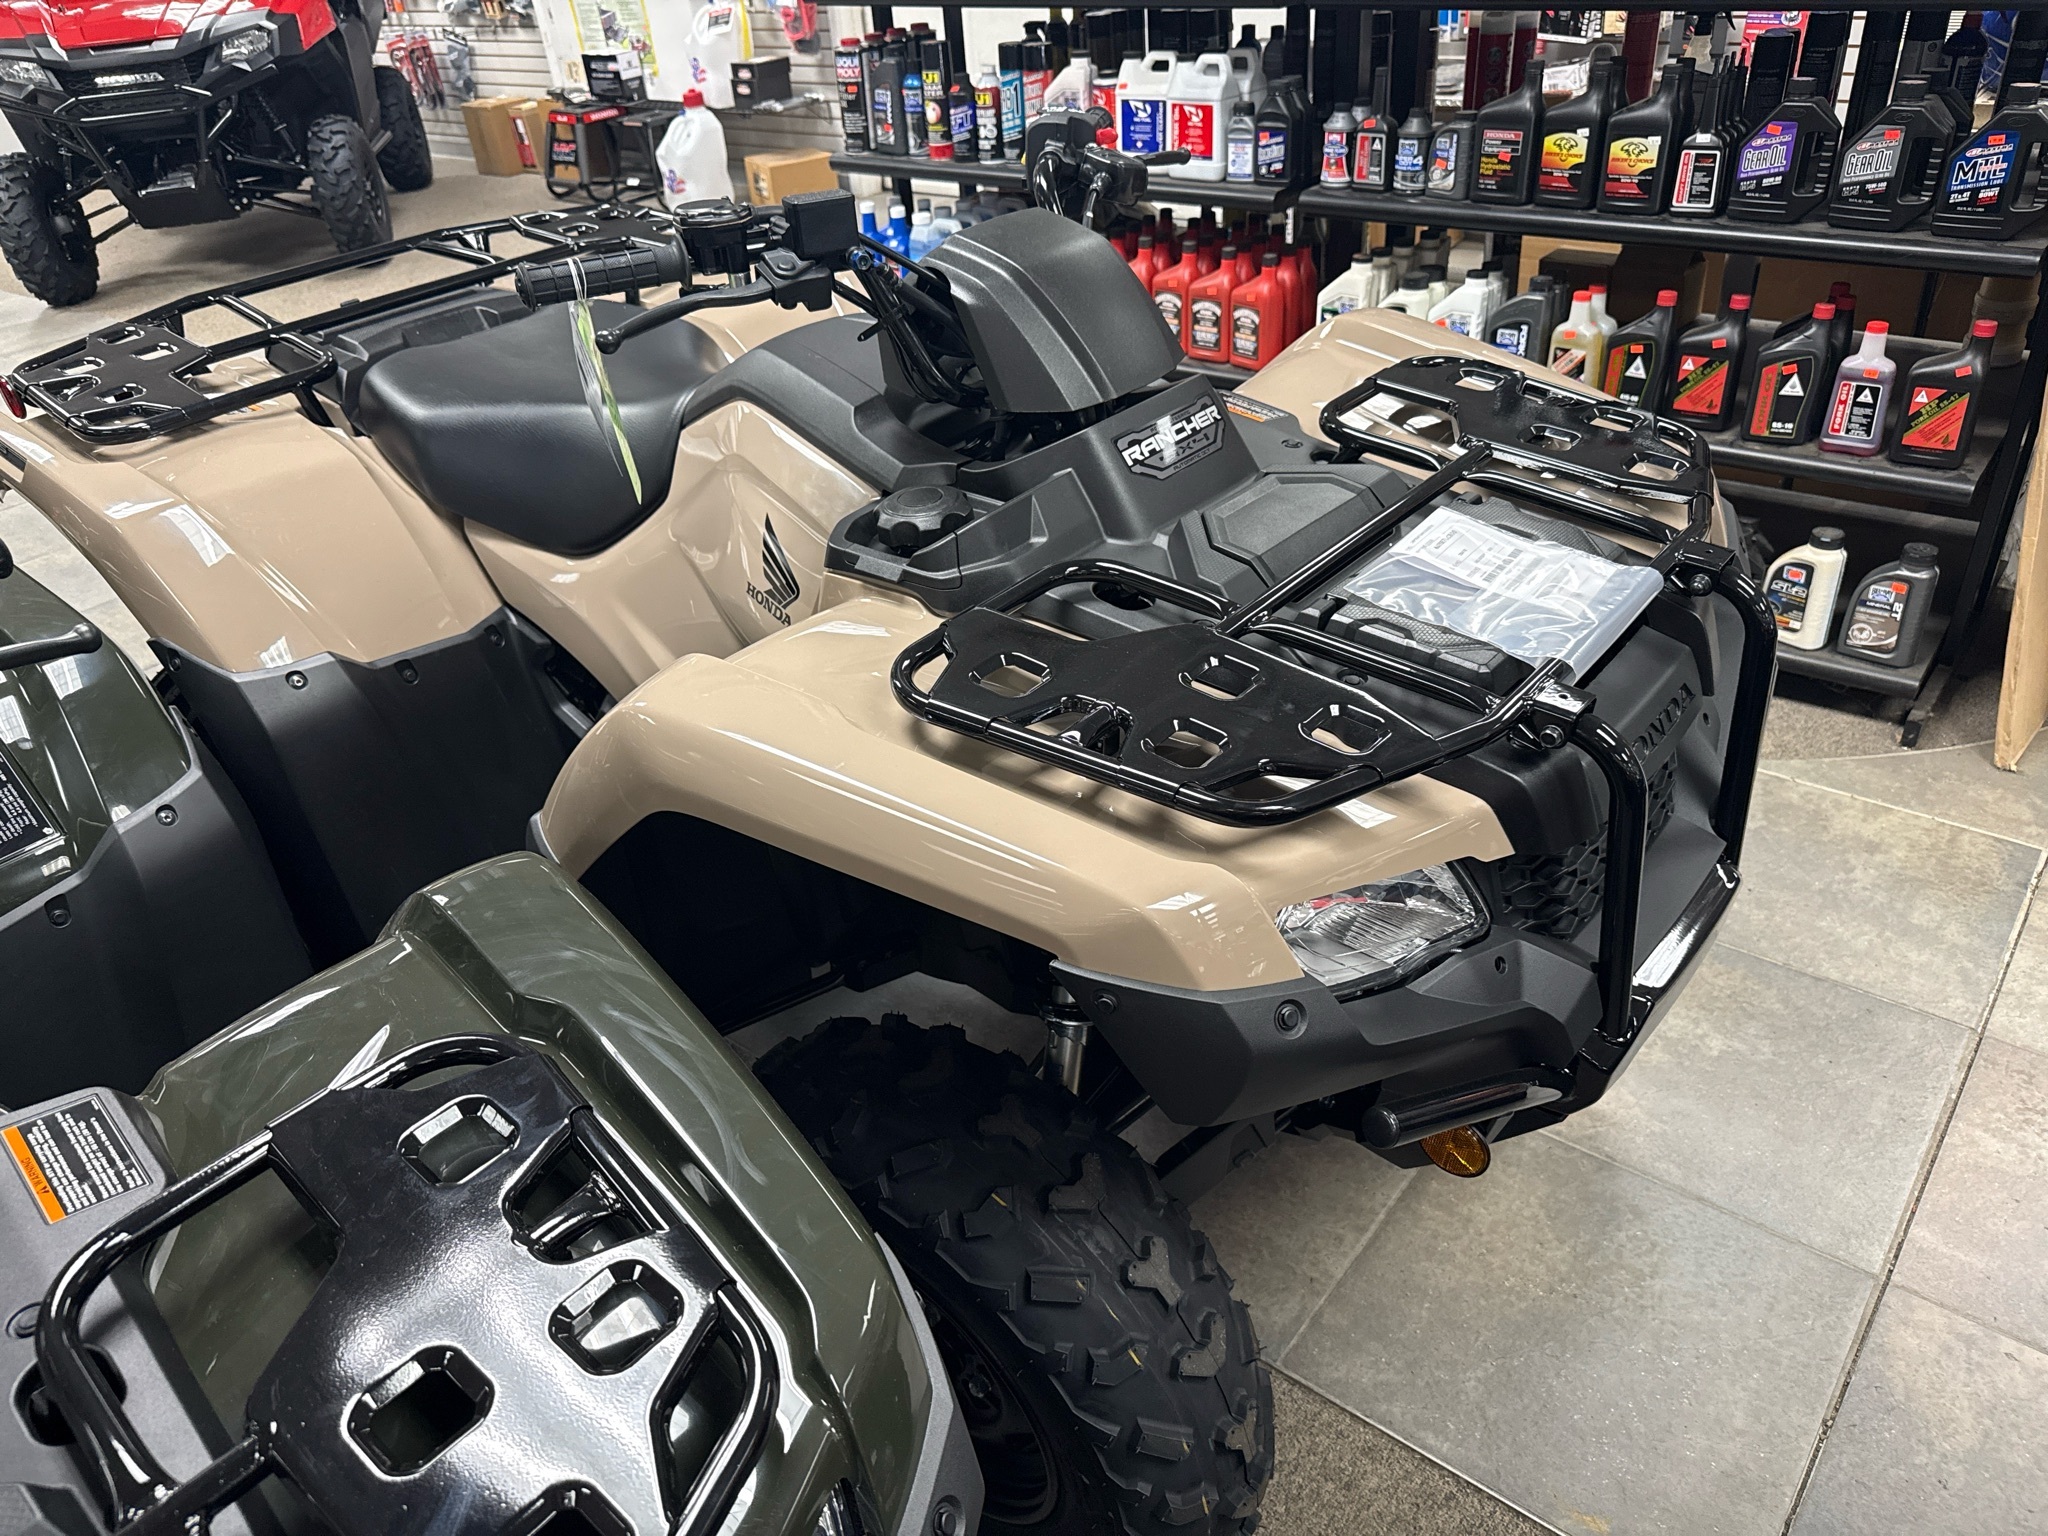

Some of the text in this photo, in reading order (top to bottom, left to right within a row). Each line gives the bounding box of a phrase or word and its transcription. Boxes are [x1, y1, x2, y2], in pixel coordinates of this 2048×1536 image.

[1742, 144, 1787, 172] GEAR OIL
[1844, 149, 1893, 177] GEAR OIL
[1952, 154, 2007, 185] MTL
[1951, 180, 1988, 192] TRANSMISSION
[1833, 384, 1849, 430] FORK OIL
[1910, 412, 1929, 428] FORK
[1928, 406, 1940, 417] OIL
[1920, 399, 1939, 414] HP
[1121, 405, 1222, 466] RANCHER
[1172, 452, 1201, 470] AUTOMATIC
[746, 581, 792, 627] HONDA
[1865, 600, 1891, 610] MINERAL
[1632, 683, 1696, 765] ONDA
[32, 1144, 49, 1163] carrying
[55, 1153, 77, 1181] performance
[20, 1156, 43, 1186] WARNING
[50, 1160, 65, 1178] change
[54, 1184, 76, 1213] Overloading
